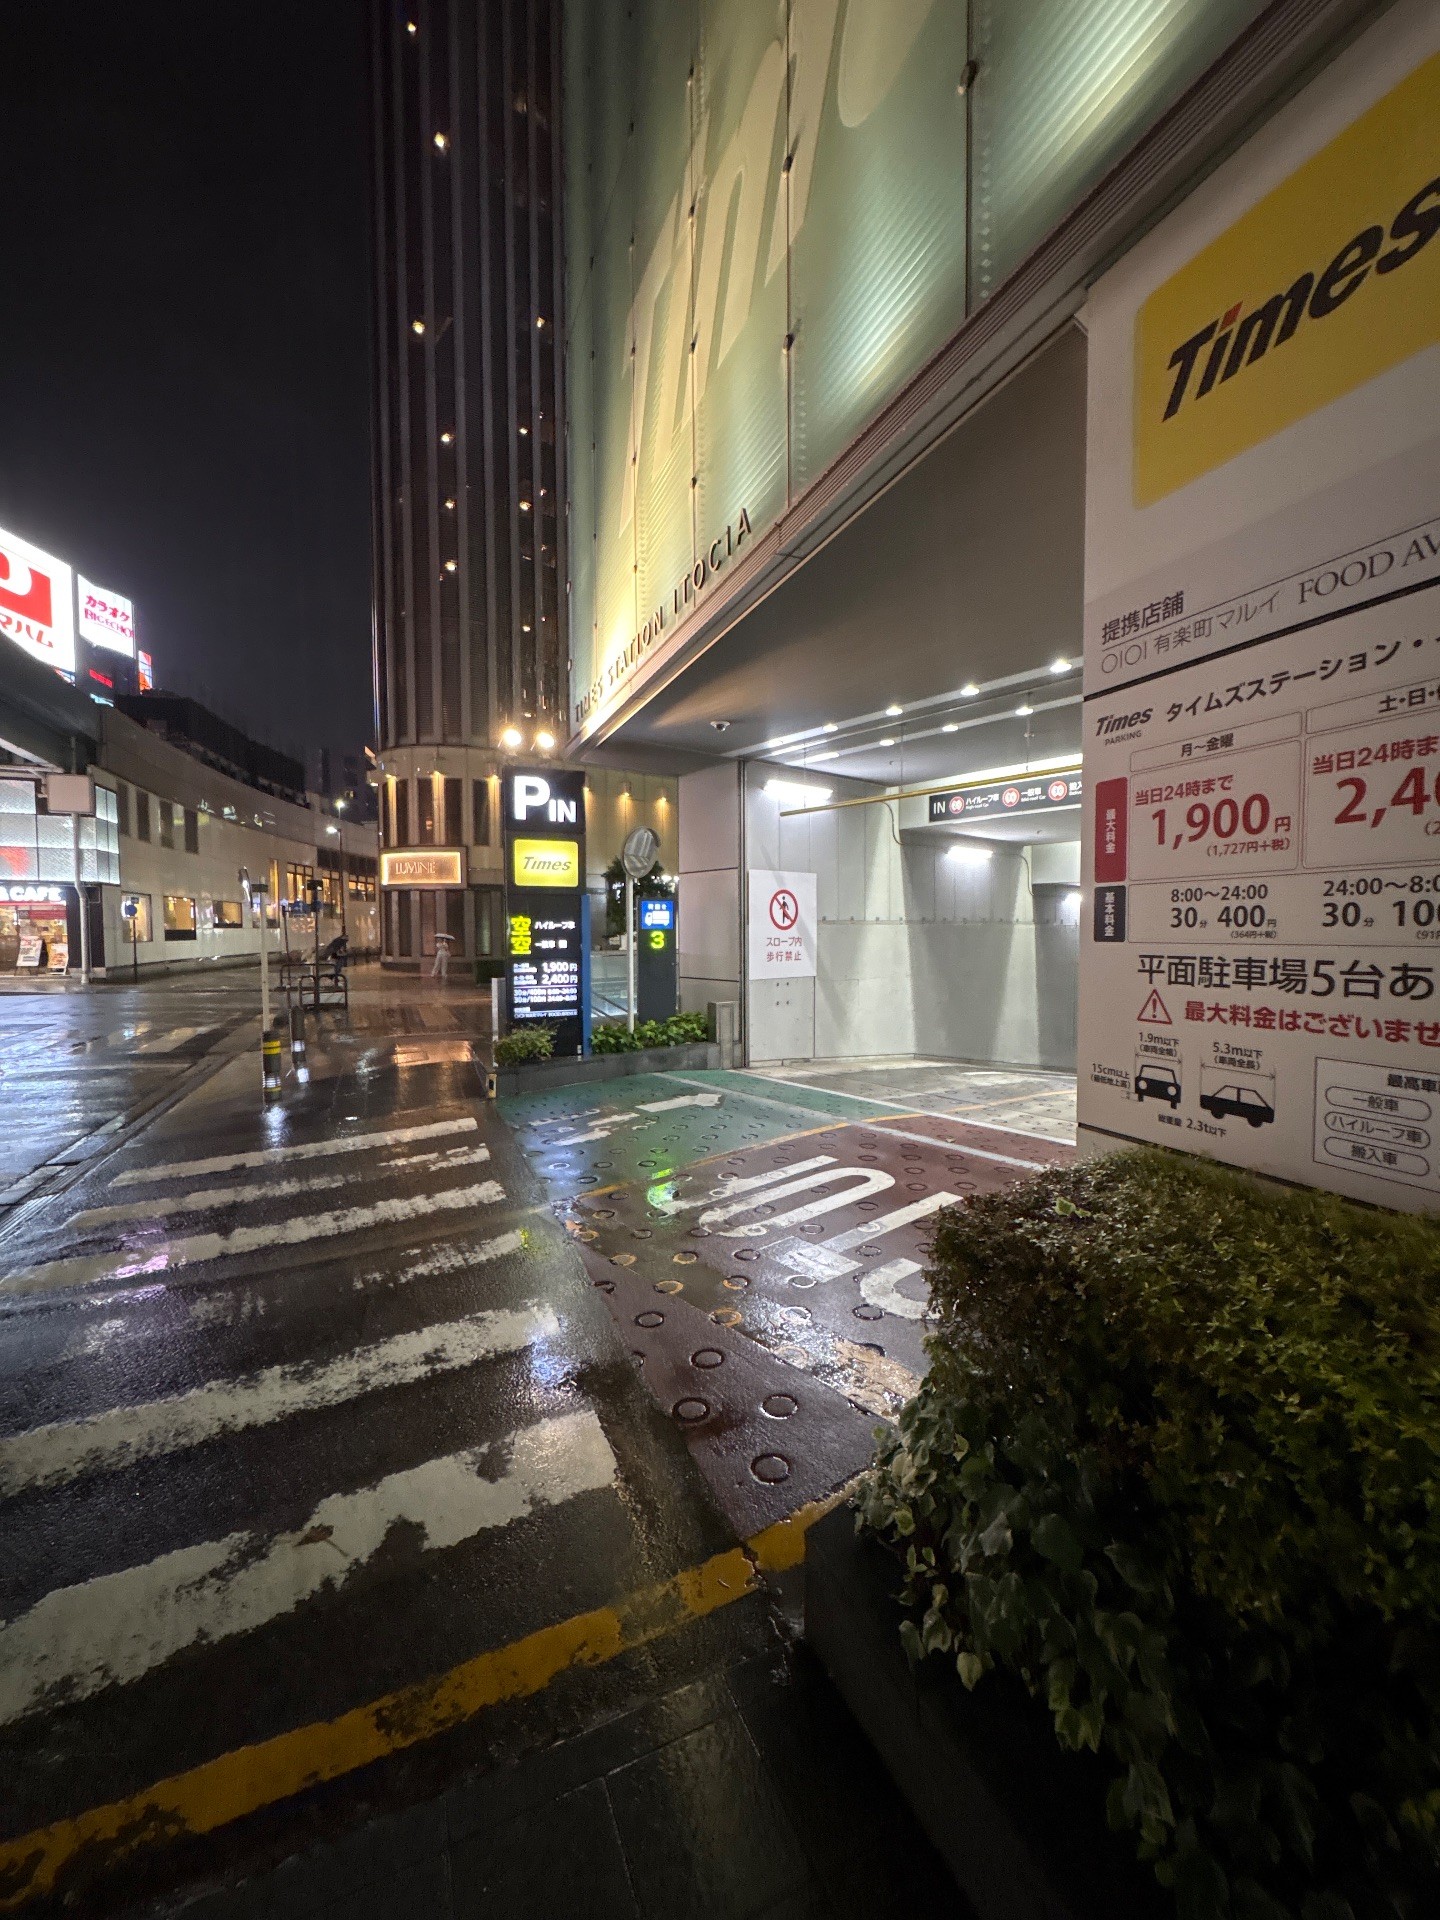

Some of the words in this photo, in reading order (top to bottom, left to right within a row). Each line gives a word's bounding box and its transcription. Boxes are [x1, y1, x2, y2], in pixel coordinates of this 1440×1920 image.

[86, 595, 130, 621] カラオケ
[608, 605, 664, 686] STATION
[673, 507, 751, 614] ITOCIA
[1154, 588, 1280, 654] 有楽町マルイ
[1298, 551, 1395, 604] FOOD
[1102, 590, 1184, 645] 提携店舗
[1166, 636, 1440, 722] タイムズステーション・
[1378, 687, 1440, 713] 土・日・
[1096, 706, 1153, 737] Times
[1104, 730, 1142, 746] PARKING
[1181, 732, 1234, 758] 月〜金曜
[1313, 735, 1440, 775] 当日24時ま
[514, 775, 550, 820] P
[548, 798, 577, 823] IN
[1135, 774, 1234, 806] 当日24時まで
[933, 801, 946, 814] IN
[1105, 808, 1116, 854] 最大料金
[395, 861, 436, 875] LUMINE
[523, 856, 572, 871] Times
[1171, 883, 1269, 903] 8:00〜24:00
[511, 916, 531, 935] 空
[1104, 892, 1115, 937] 基本料金
[1170, 906, 1208, 928] 30分
[1217, 905, 1277, 928] 400円
[1322, 901, 1375, 928] 30分
[511, 935, 531, 954] 空
[650, 930, 665, 949] 3
[766, 936, 802, 947] スロープ内
[766, 951, 802, 962] 歩行禁止
[1137, 954, 1435, 1001] 平面駐車場5台あ
[1138, 1031, 1180, 1047] 1.9m以下
[1212, 1041, 1263, 1059] 5.3m以下
[1387, 1073, 1440, 1094] 最高車
[1352, 1095, 1399, 1112] 一般車
[1331, 1116, 1422, 1143] ハイルーフ車
